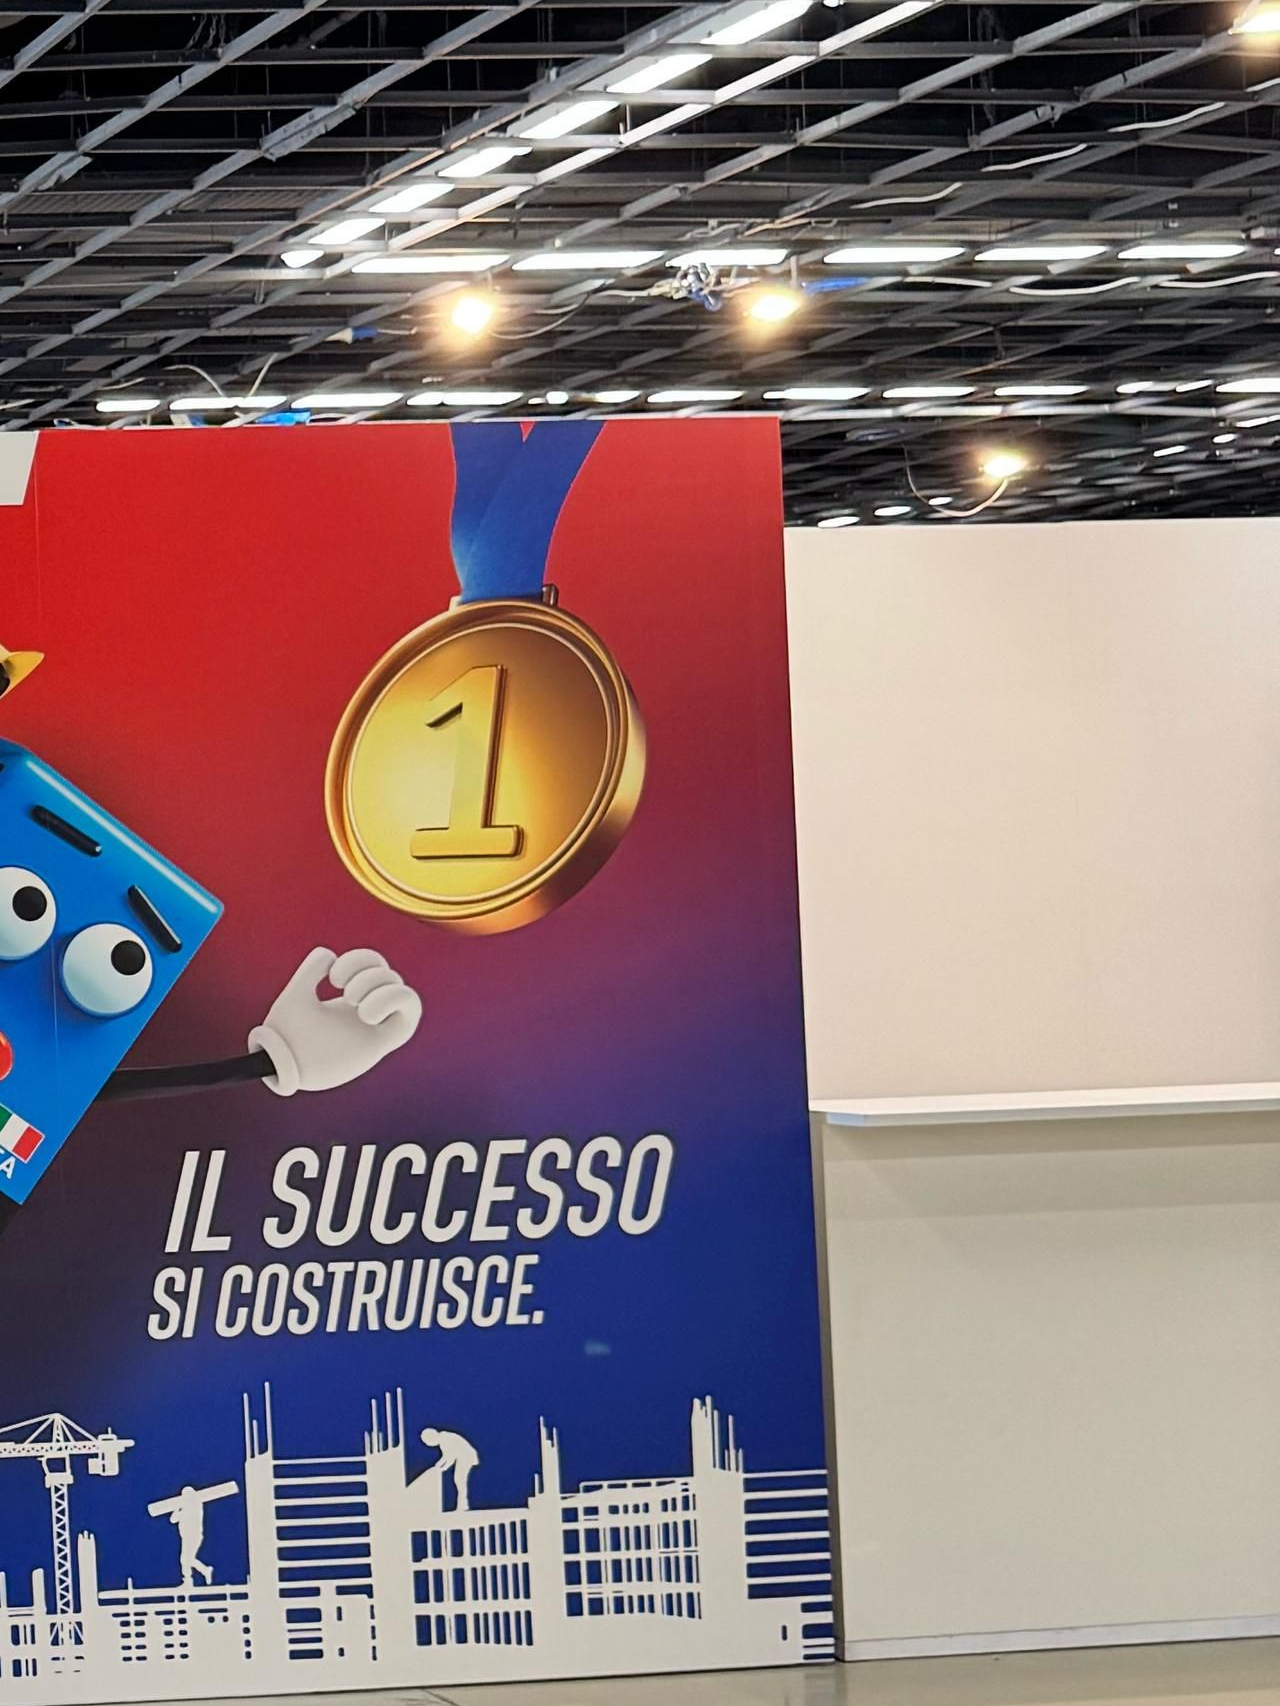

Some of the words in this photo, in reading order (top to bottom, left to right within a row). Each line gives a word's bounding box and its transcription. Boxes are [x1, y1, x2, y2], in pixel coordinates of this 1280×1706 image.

[410, 664, 524, 859] 1
[165, 1150, 232, 1253] IL
[262, 1134, 674, 1249] SUCCESSO
[147, 1267, 203, 1340] SI
[214, 1254, 544, 1337] COSTRUISCE.
